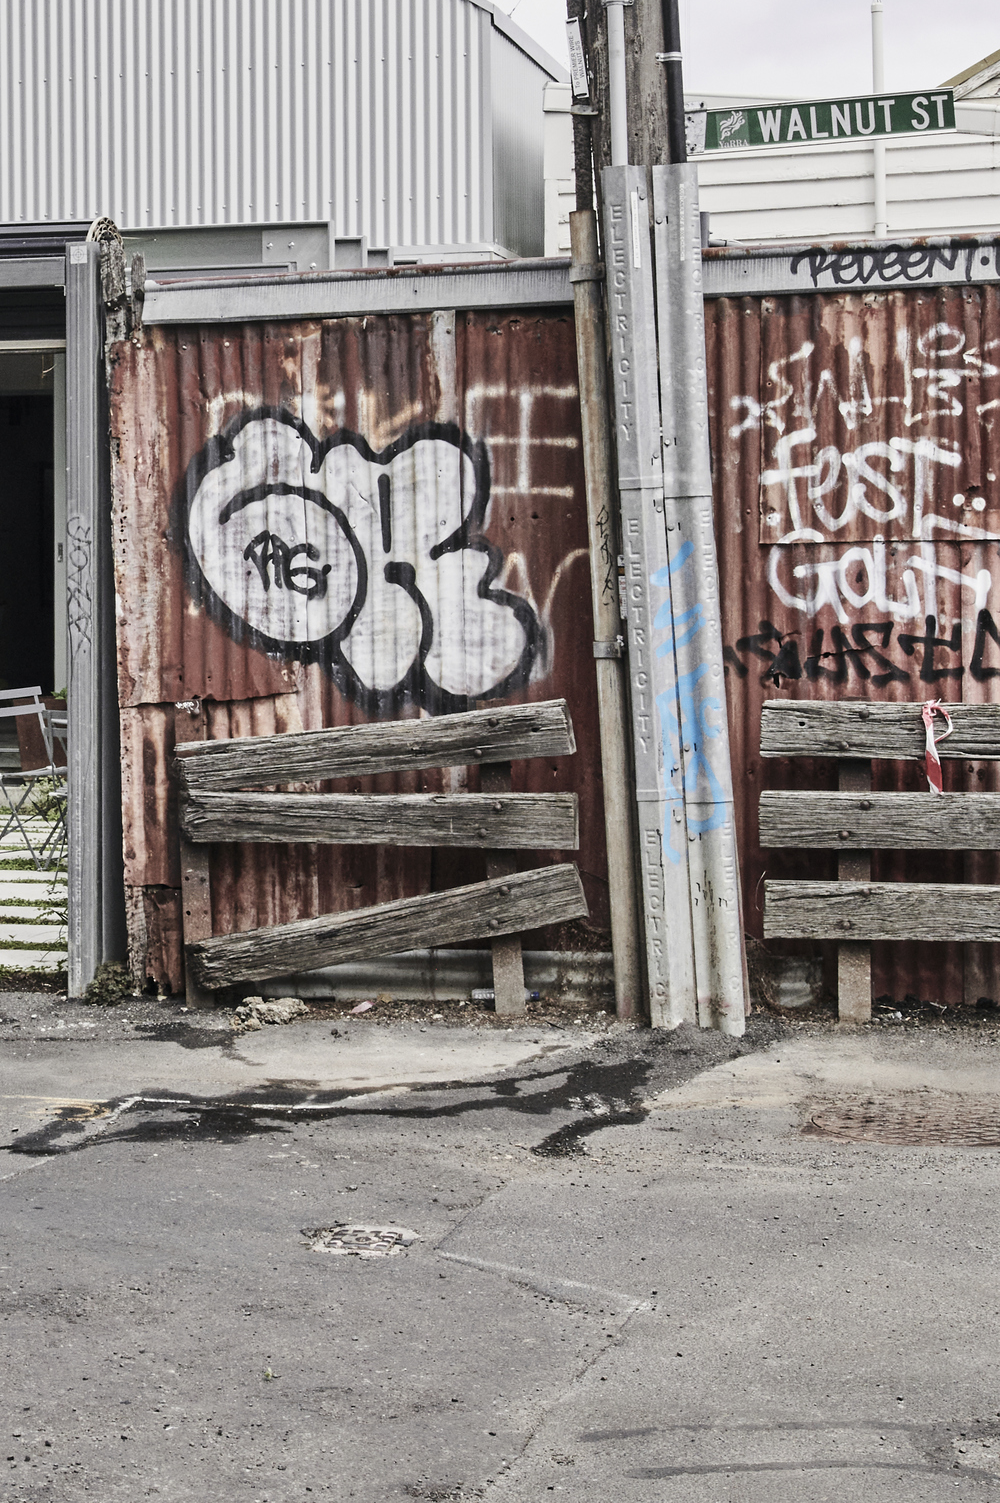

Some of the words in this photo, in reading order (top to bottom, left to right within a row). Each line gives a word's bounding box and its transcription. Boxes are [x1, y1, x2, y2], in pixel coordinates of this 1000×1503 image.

[570, 52, 579, 81] PREMIER
[757, 99, 895, 142] WALNUT
[911, 95, 948, 130] ST
[610, 204, 631, 441] ELECTRICITY
[627, 518, 650, 754] ELECTRICITY
